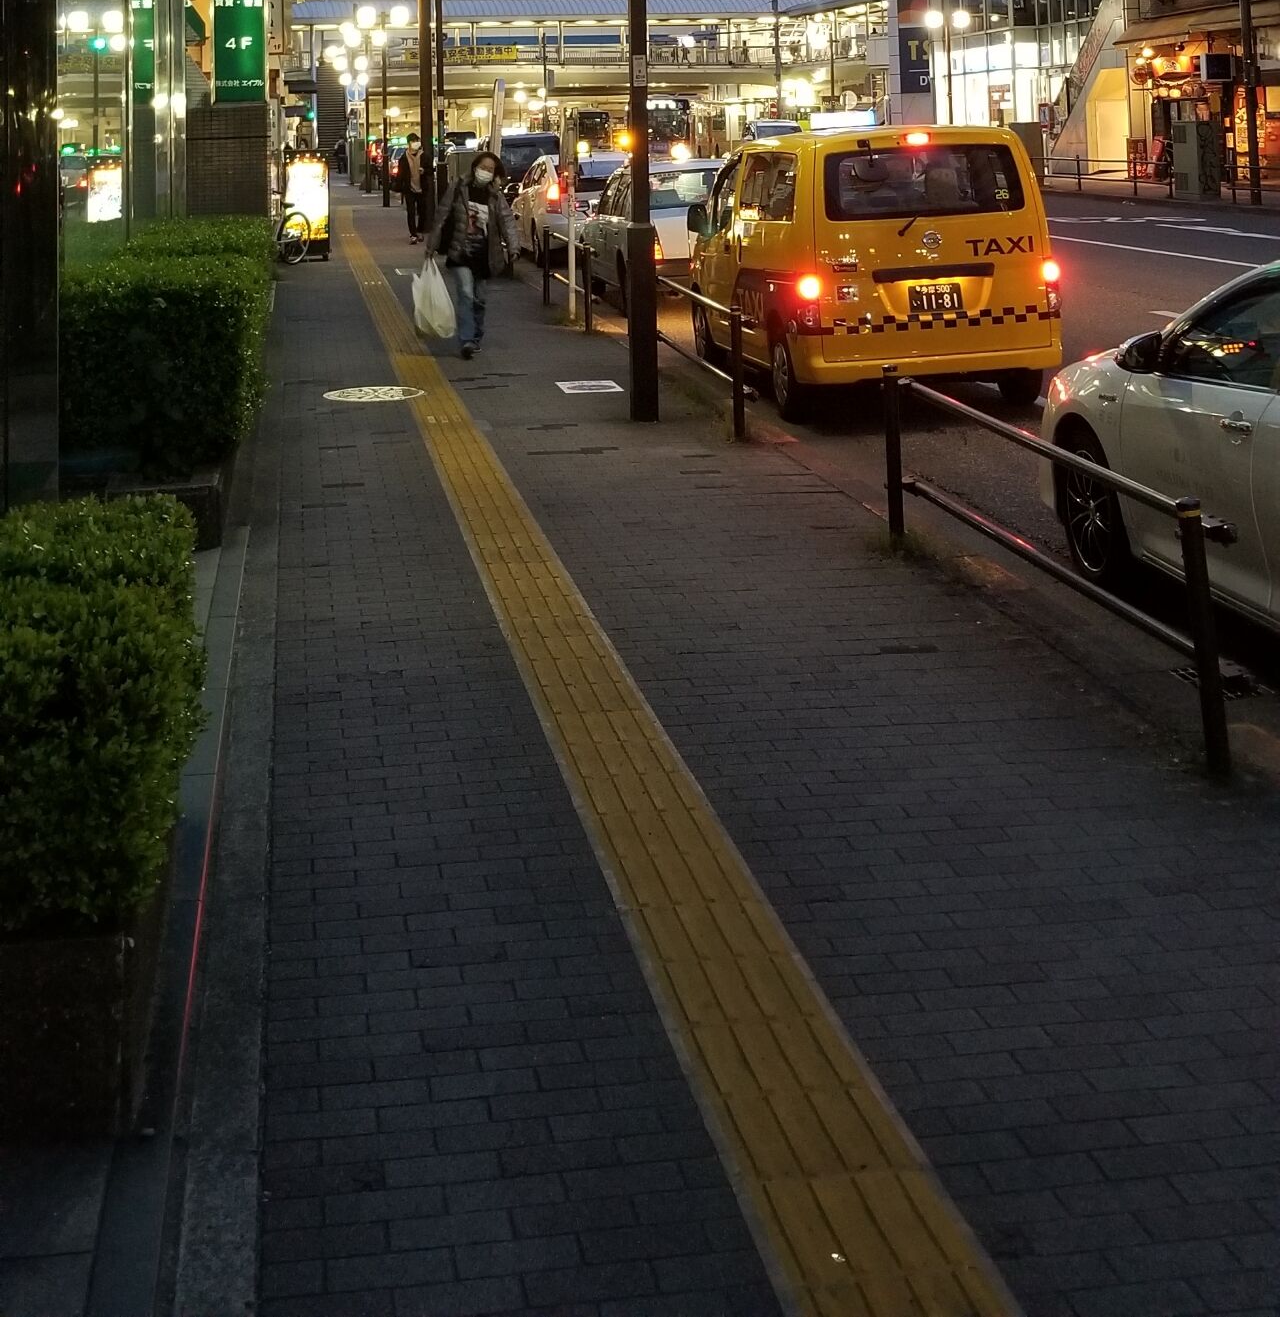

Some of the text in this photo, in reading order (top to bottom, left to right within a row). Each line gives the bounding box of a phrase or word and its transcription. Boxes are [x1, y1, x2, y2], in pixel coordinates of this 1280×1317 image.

[225, 36, 253, 50] 4F
[994, 188, 1010, 200] 26
[965, 235, 1034, 257] TAXI
[936, 284, 951, 294] 500
[922, 292, 959, 310] 11-81
